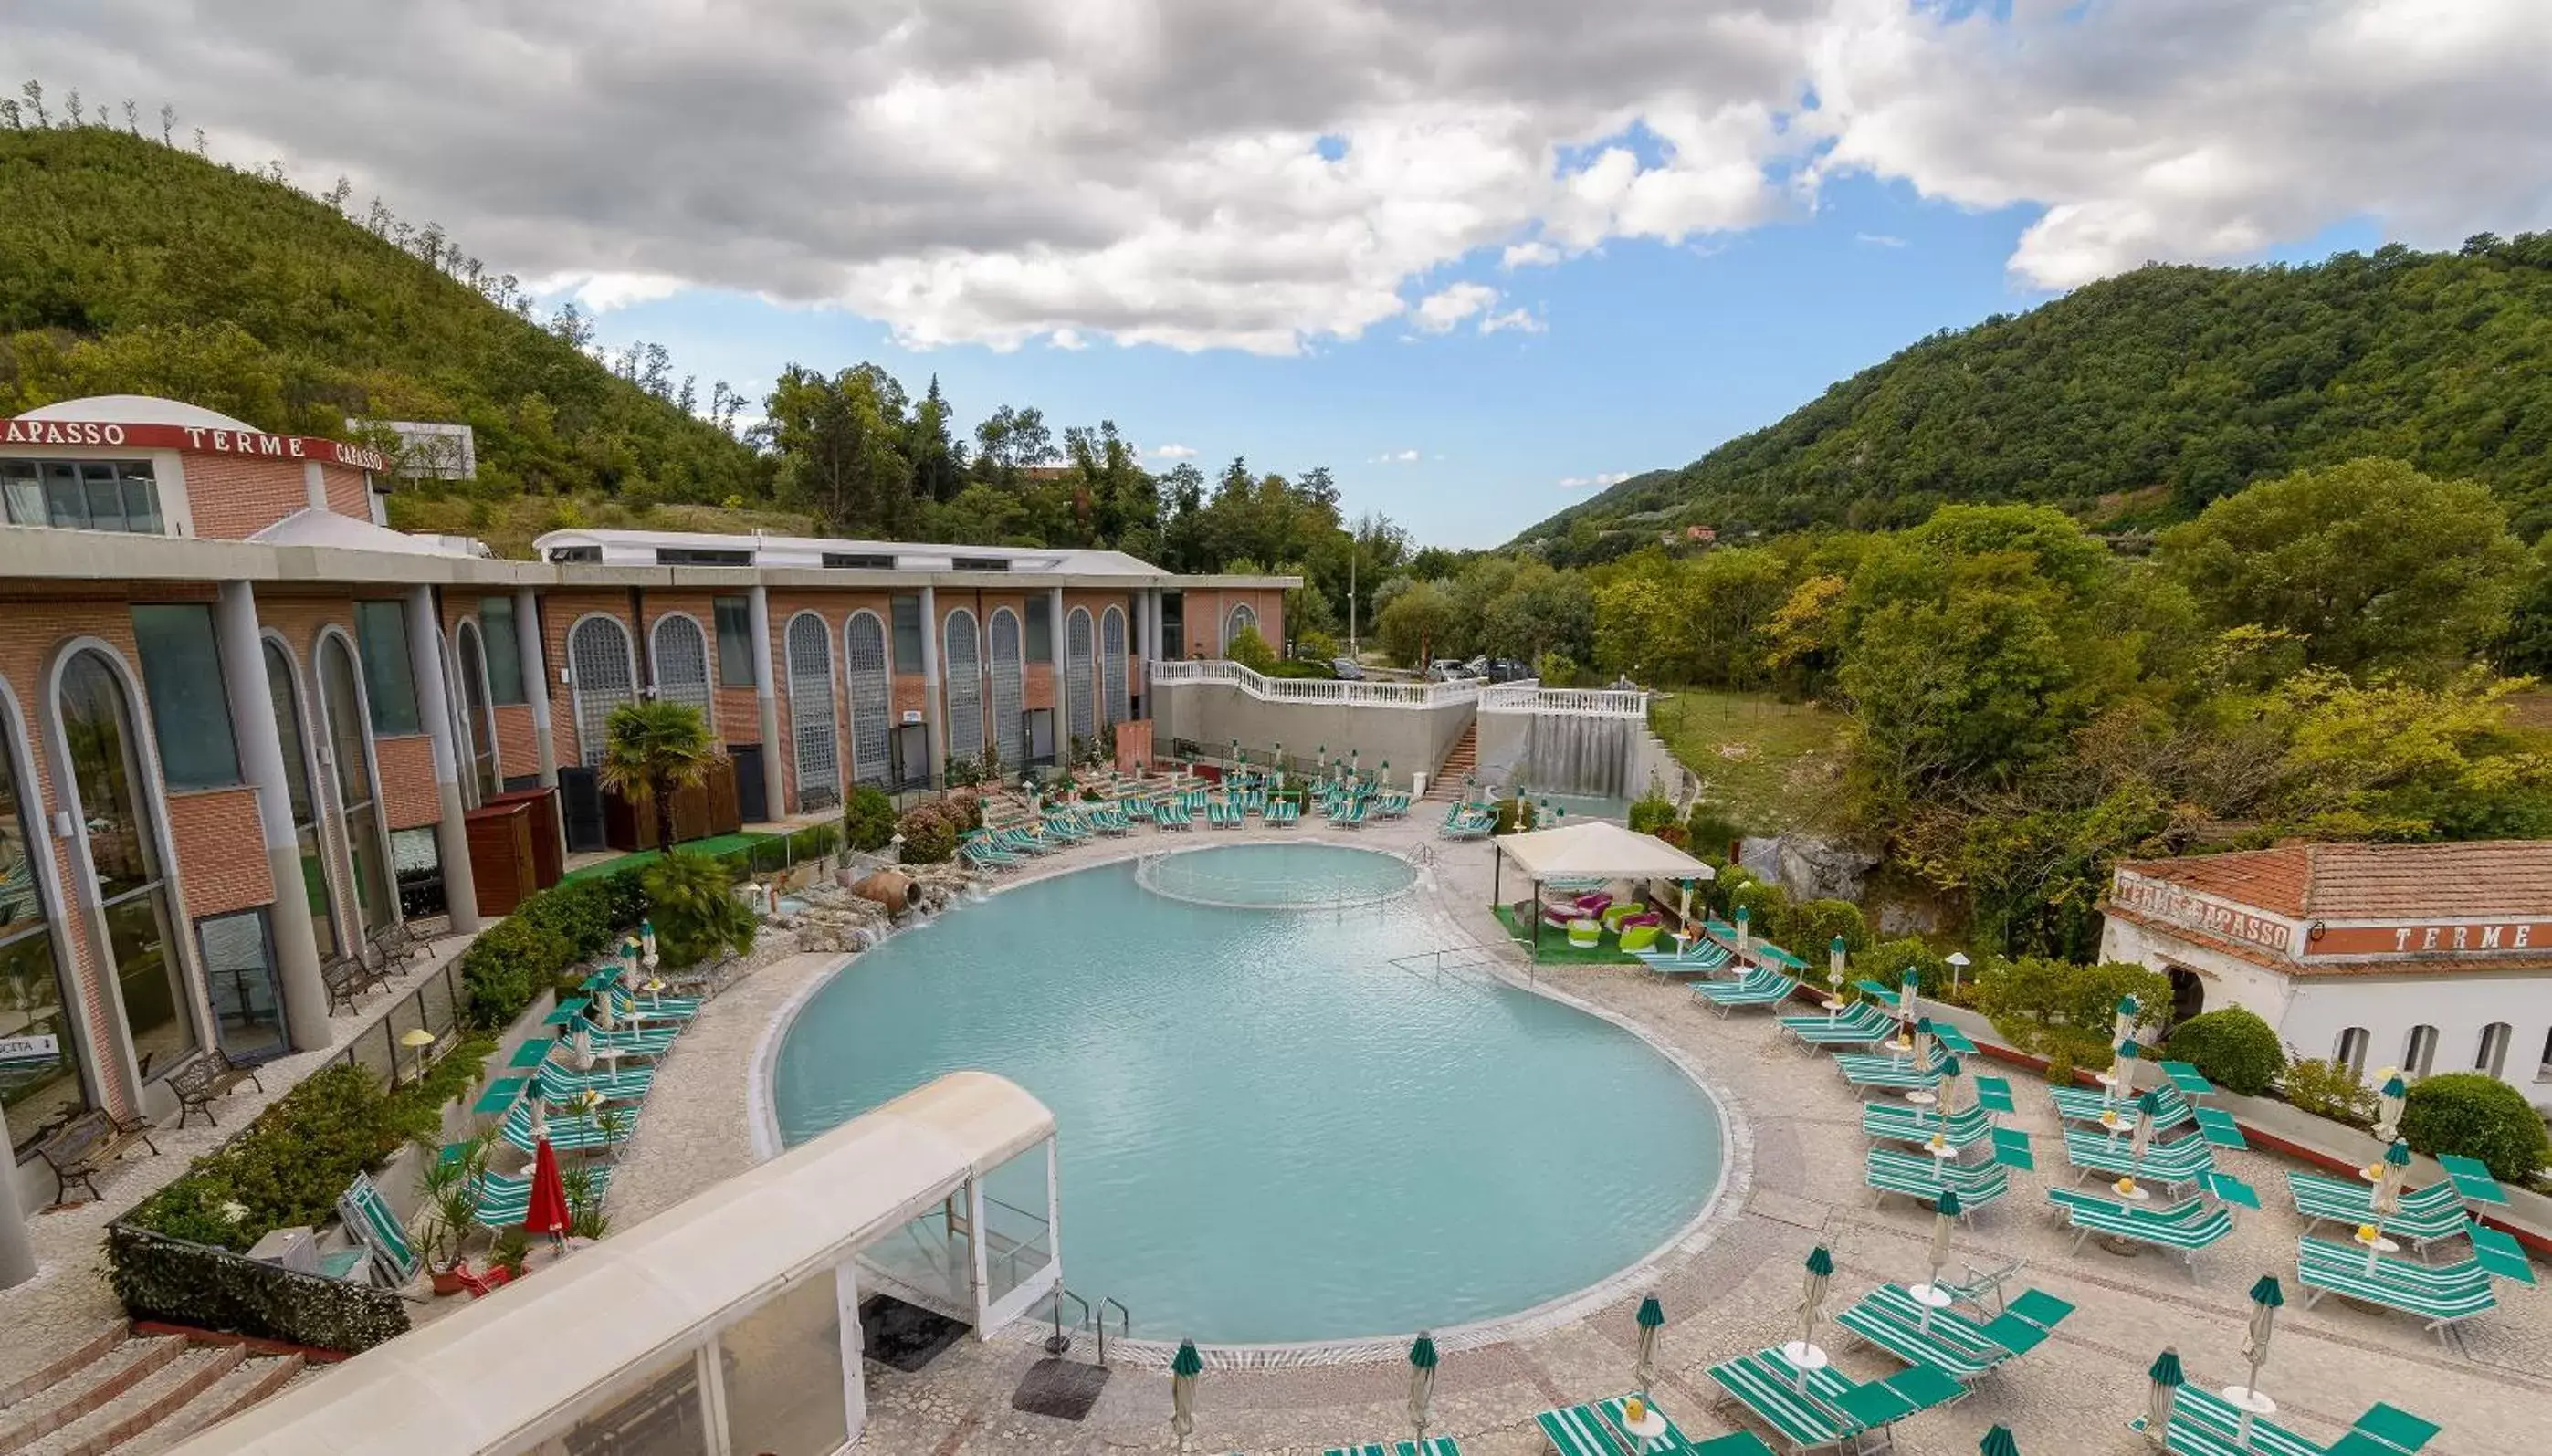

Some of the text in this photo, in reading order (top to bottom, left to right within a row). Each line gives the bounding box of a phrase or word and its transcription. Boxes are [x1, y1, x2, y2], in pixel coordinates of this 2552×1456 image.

[0, 421, 382, 470] APASSO TERME CAPASSO
[2396, 925, 2531, 950] TERME
